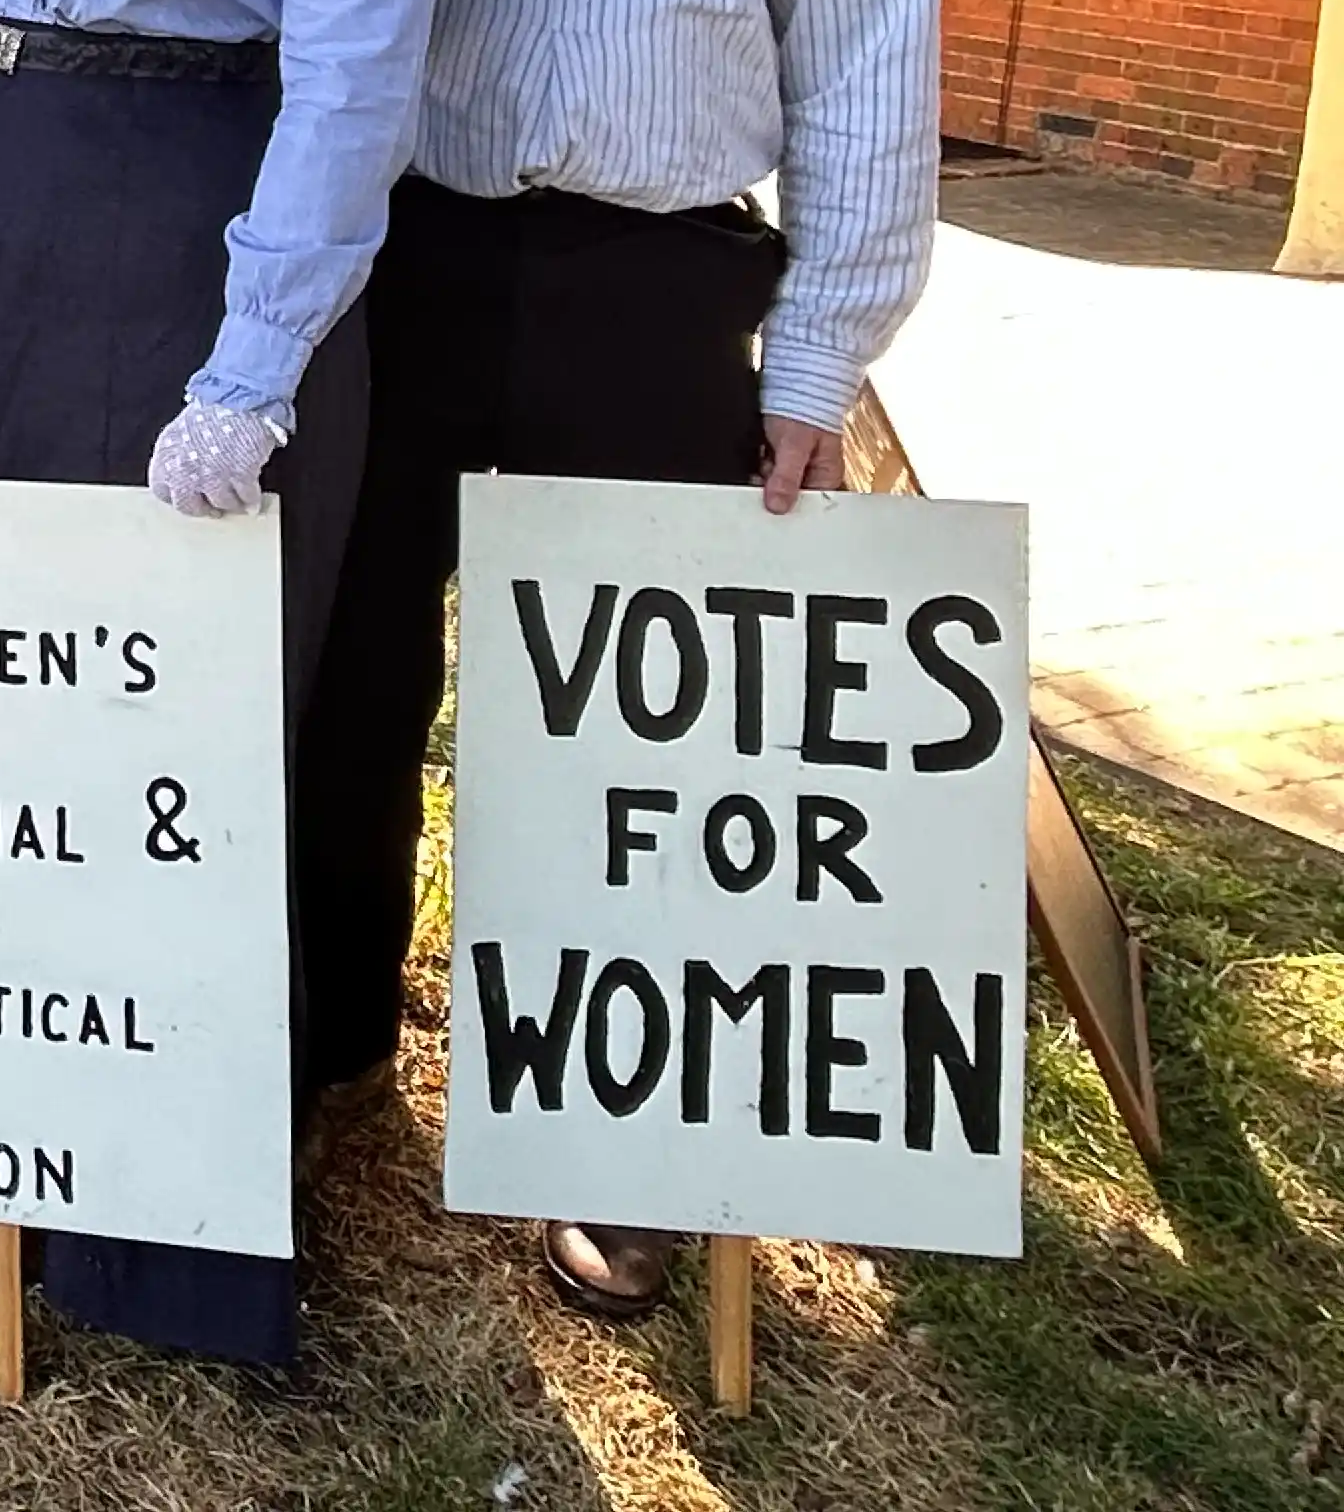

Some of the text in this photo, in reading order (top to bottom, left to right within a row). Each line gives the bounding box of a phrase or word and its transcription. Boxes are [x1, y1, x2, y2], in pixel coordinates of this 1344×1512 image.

[511, 579, 1003, 773] VOTES
[145, 776, 202, 863] &
[606, 787, 884, 904] FOR
[470, 941, 1004, 1156] WOMEN
